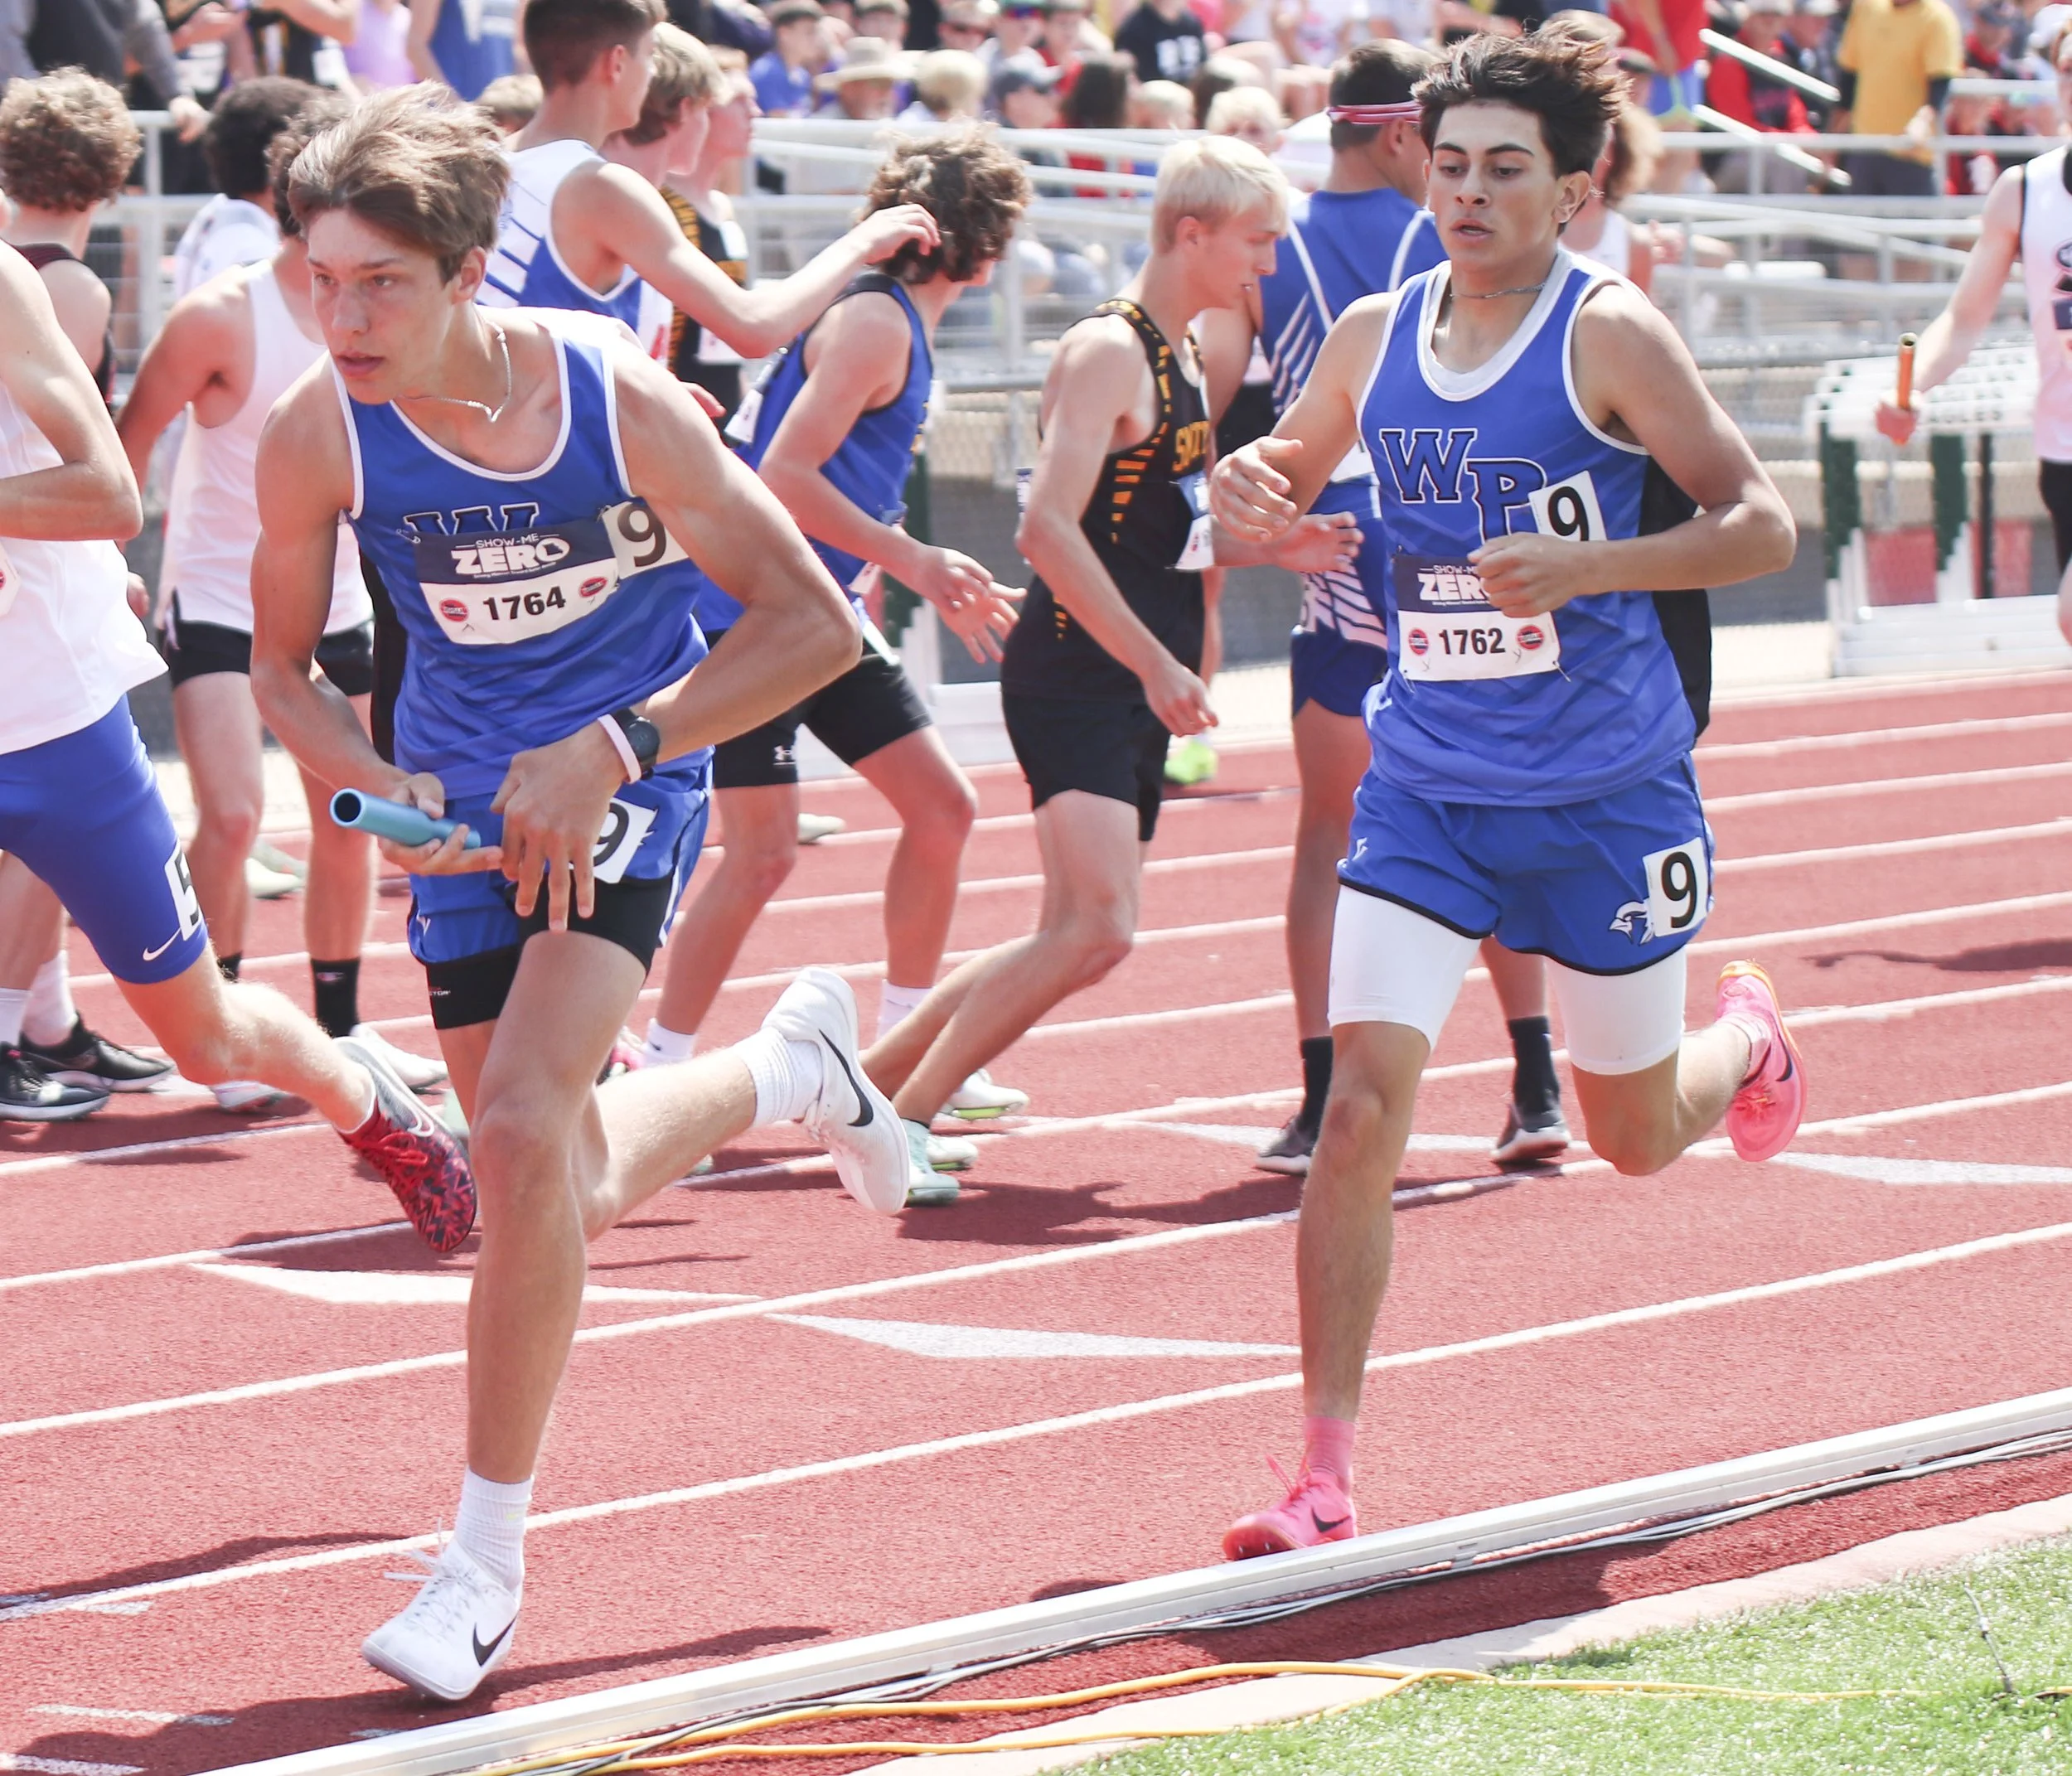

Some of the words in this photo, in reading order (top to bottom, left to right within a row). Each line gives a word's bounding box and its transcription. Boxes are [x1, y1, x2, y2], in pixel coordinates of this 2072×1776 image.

[1547, 486, 1590, 541] 9
[475, 533, 540, 549] SHOW-ME
[617, 502, 667, 568] 9
[451, 537, 570, 575] ZERO
[482, 586, 567, 621] 1764
[1416, 573, 1489, 601] ZER
[1438, 627, 1506, 655] 1762
[593, 801, 630, 868] 9
[1661, 851, 1697, 929] 9
